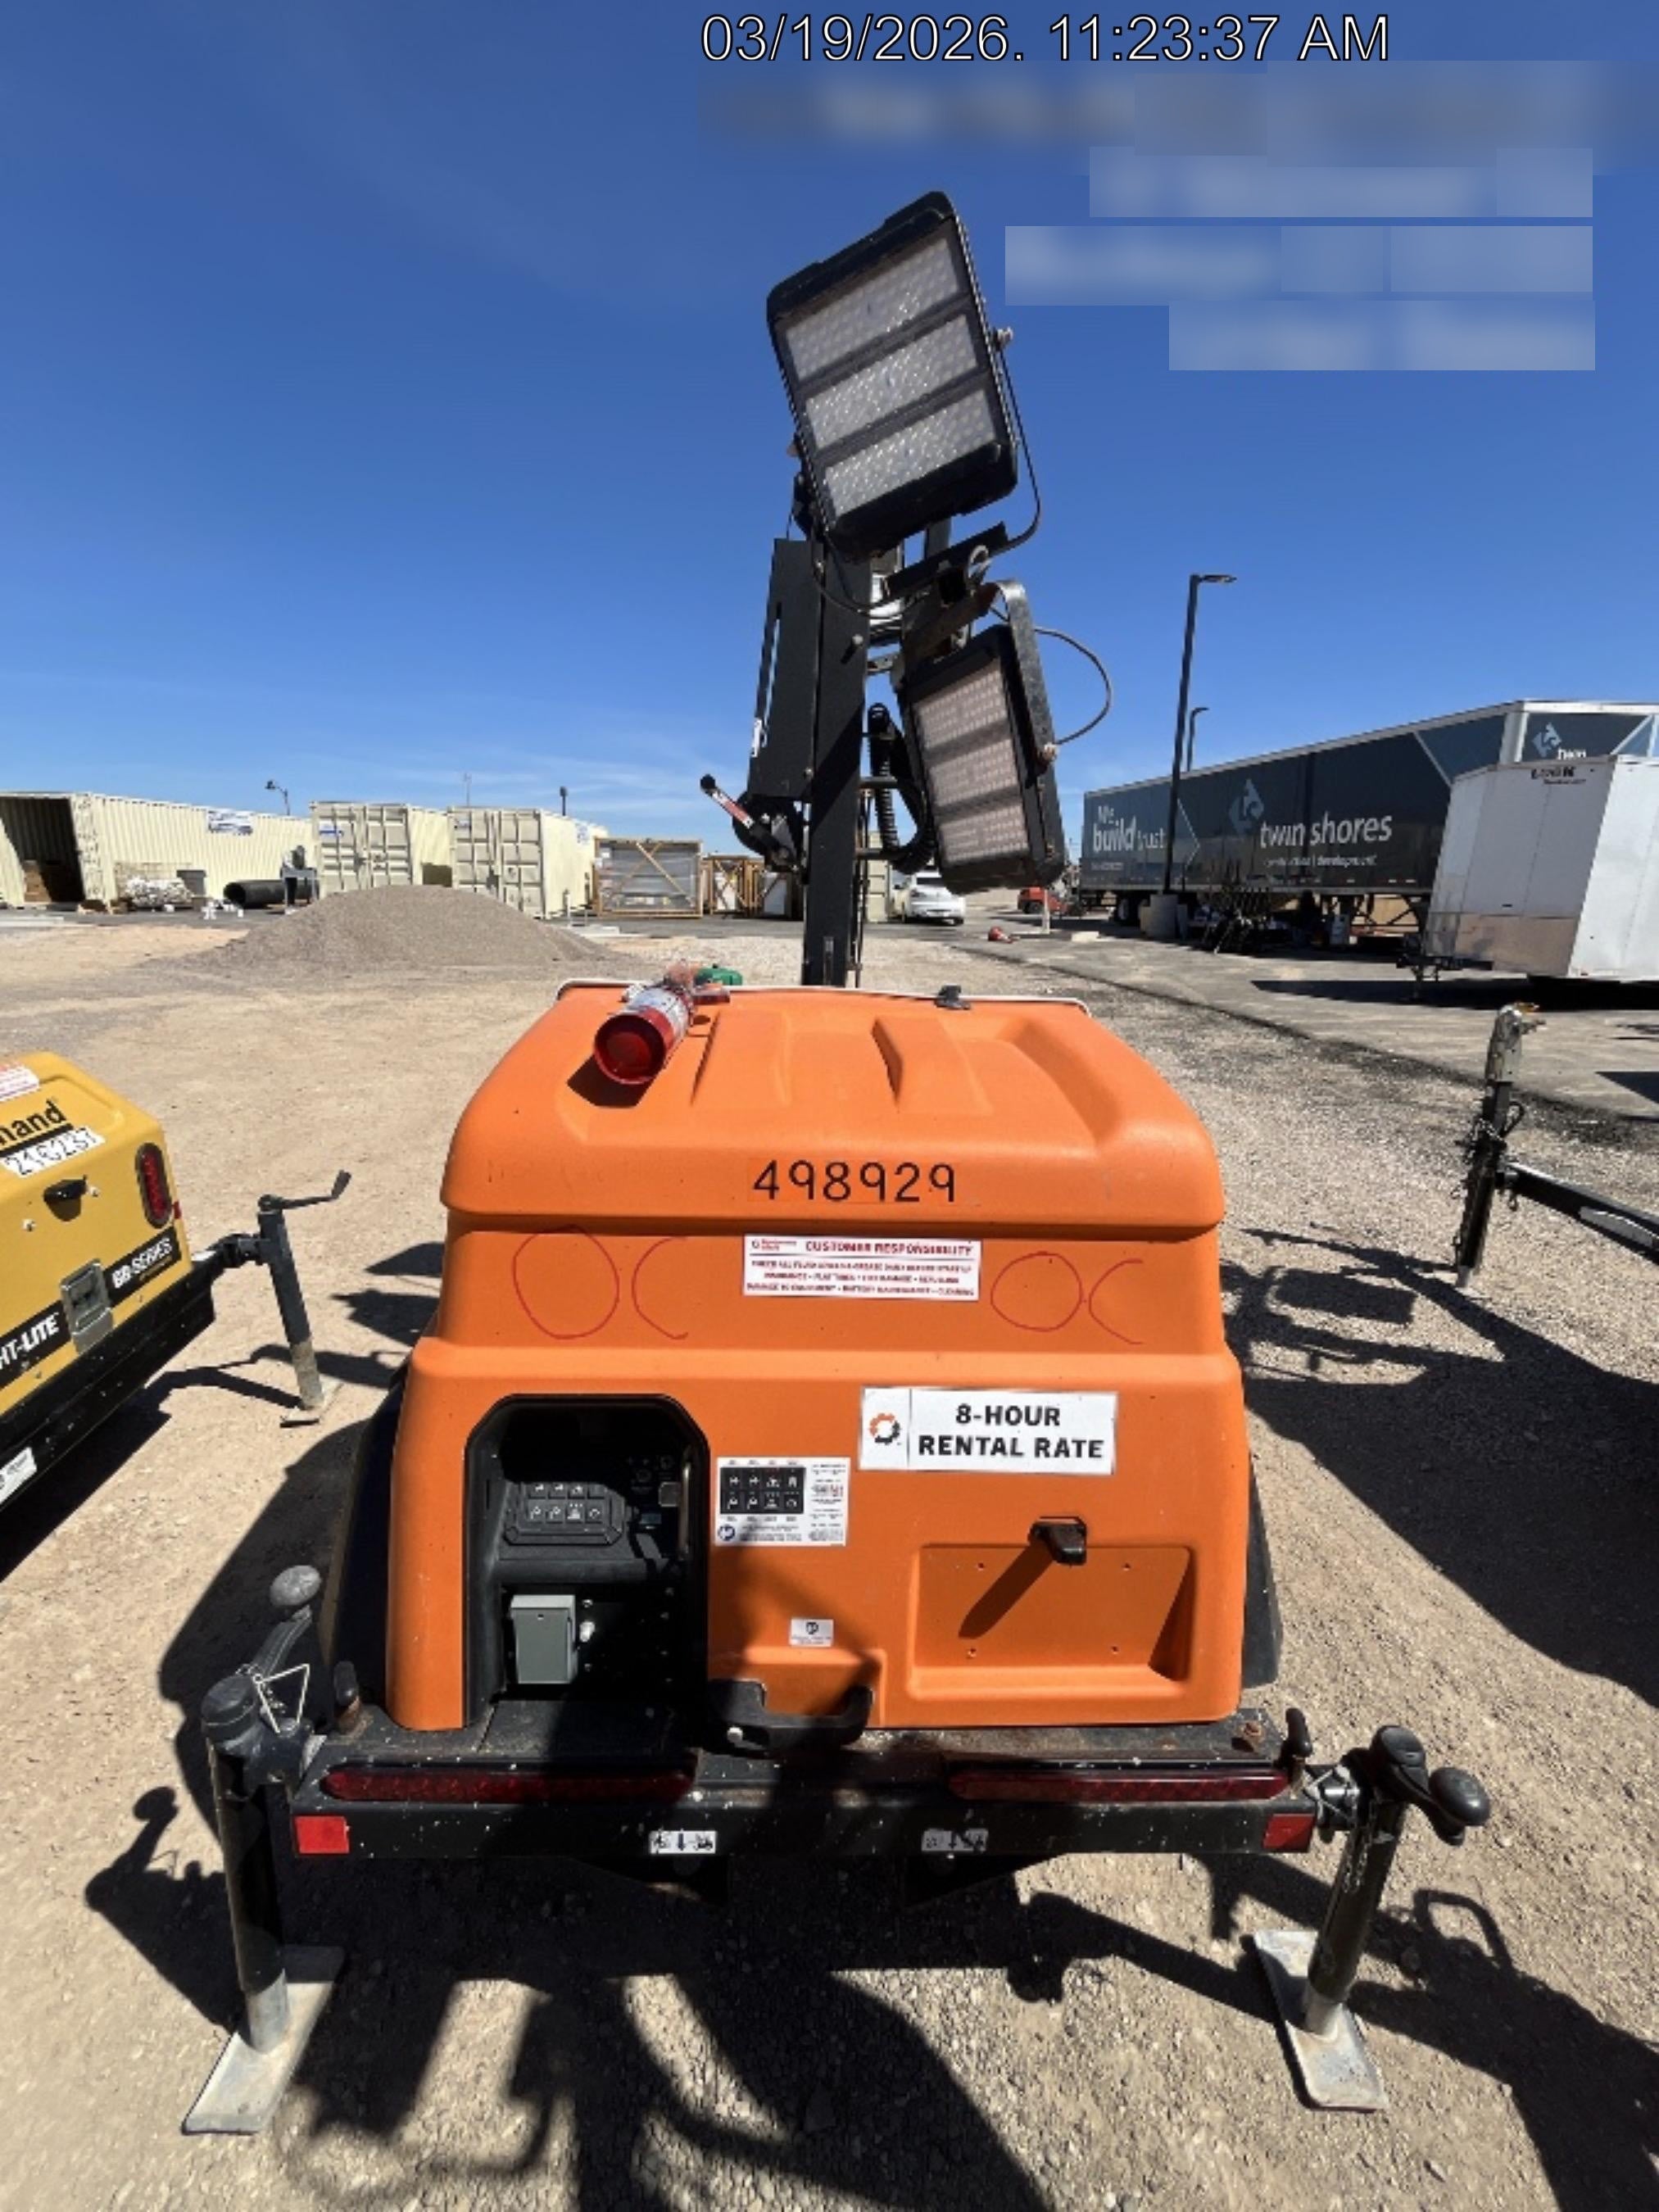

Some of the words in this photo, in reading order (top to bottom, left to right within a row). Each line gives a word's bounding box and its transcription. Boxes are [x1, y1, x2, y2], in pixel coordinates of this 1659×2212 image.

[1094, 815, 1136, 853] build
[1260, 821, 1306, 849] twin
[1310, 810, 1393, 846] shores
[753, 1159, 954, 1202] 498929
[955, 1403, 1060, 1426] 8-HOUR
[918, 1435, 1024, 1457] RENTAL
[1034, 1438, 1104, 1458] RATE
